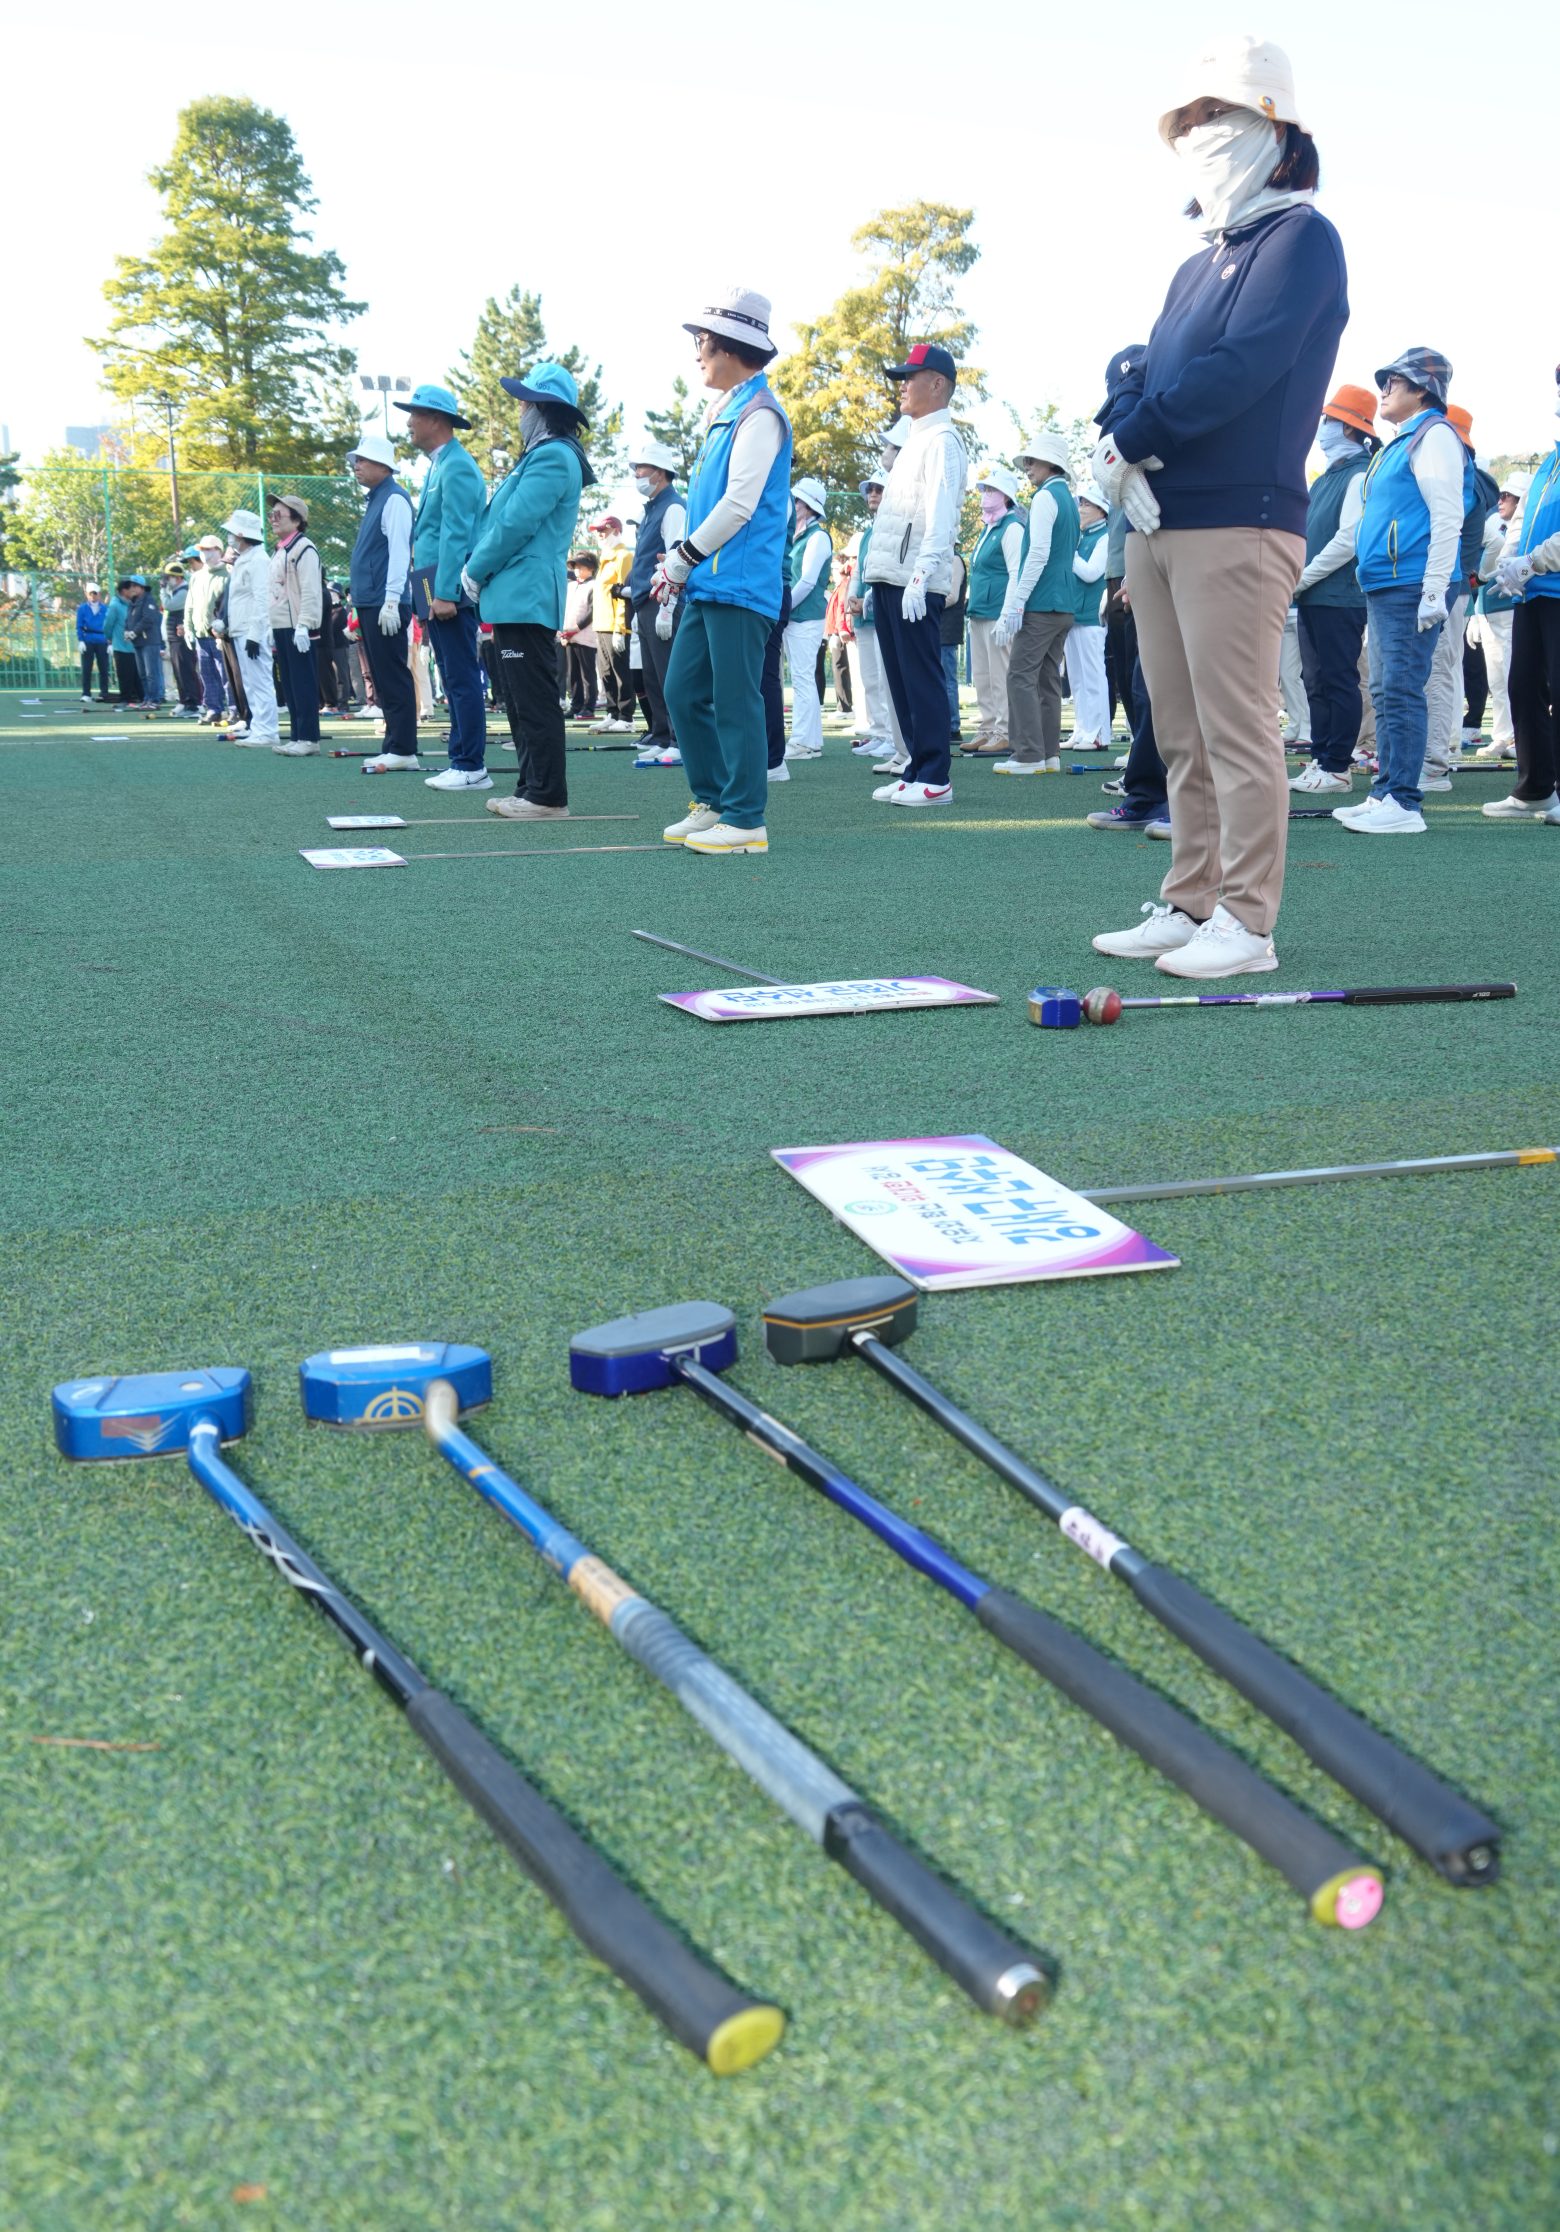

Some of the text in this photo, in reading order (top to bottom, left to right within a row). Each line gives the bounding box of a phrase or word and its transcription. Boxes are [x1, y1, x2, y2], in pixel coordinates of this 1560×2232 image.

[716, 989, 815, 1003] 선수단
[815, 981, 918, 996] 기장군
[904, 1155, 1102, 1246] 강서구 선수단
